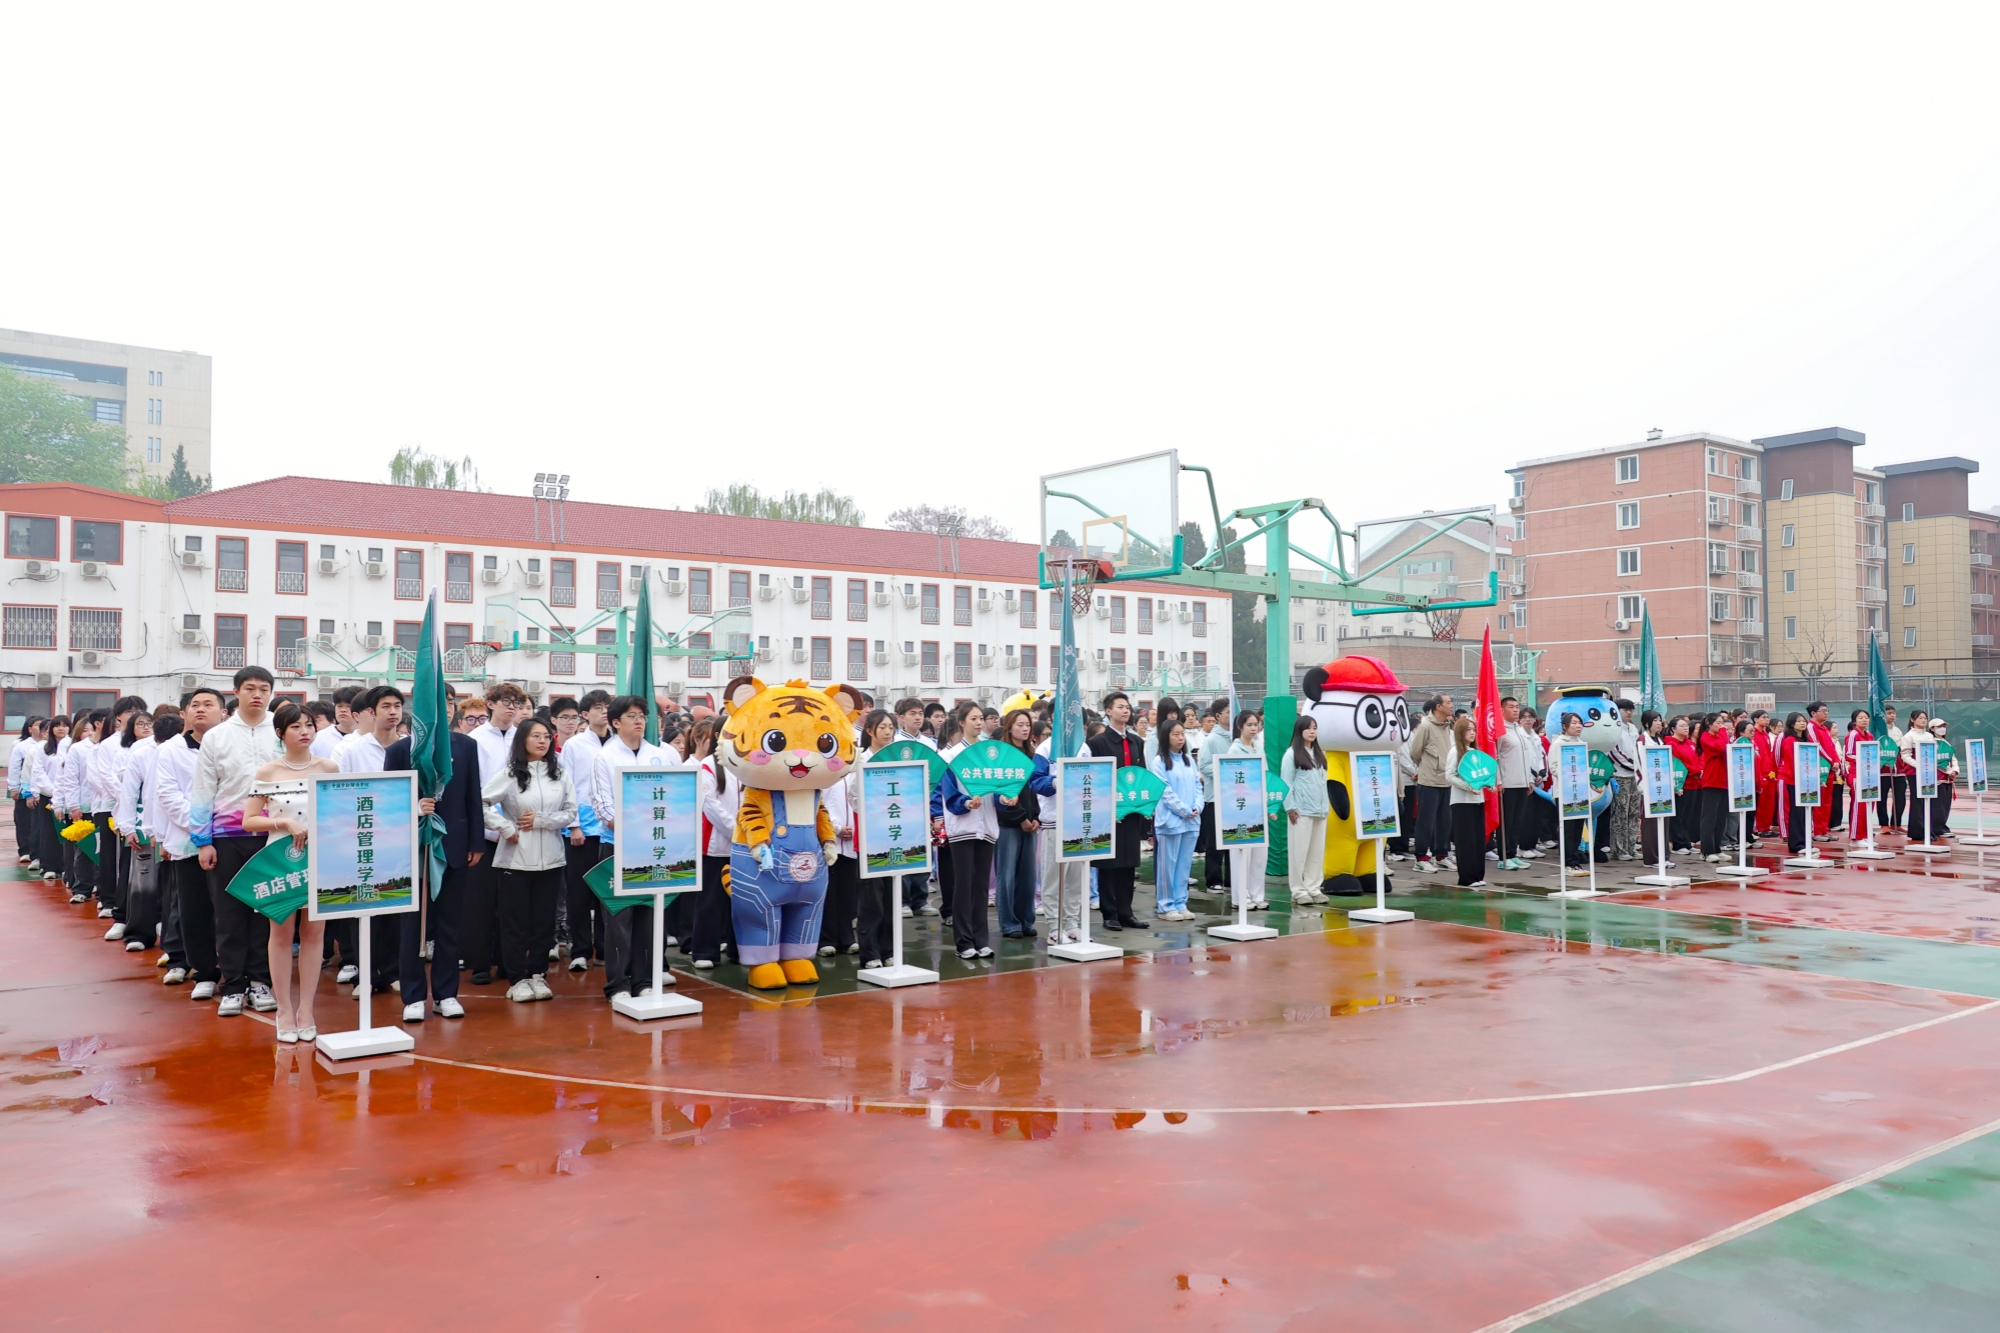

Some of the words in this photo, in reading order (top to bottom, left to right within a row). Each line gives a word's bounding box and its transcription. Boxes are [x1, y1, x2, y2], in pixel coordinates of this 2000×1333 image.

[961, 767, 1026, 780] 公共管理学院
[1234, 771, 1249, 838] 法学院
[1265, 791, 1283, 801] 学院
[1369, 765, 1386, 830] 安全工程学院
[652, 786, 666, 881] 计算机学院
[886, 781, 904, 865] 工会学院
[1082, 774, 1093, 850] 公共管理学院
[356, 796, 374, 901] 酒店管理学院
